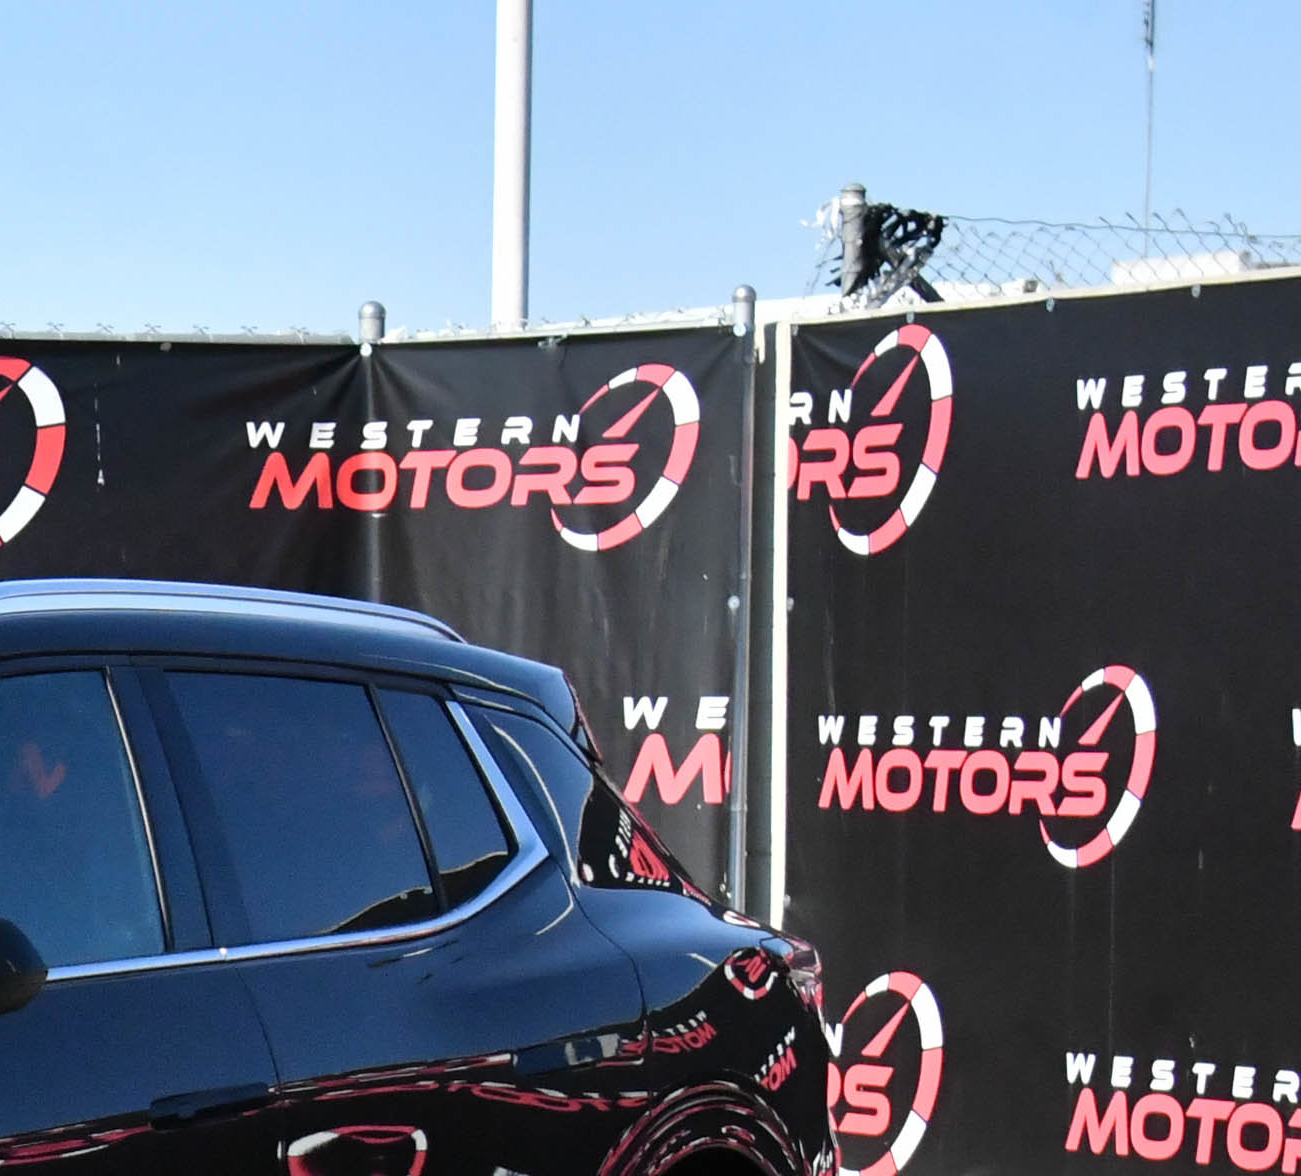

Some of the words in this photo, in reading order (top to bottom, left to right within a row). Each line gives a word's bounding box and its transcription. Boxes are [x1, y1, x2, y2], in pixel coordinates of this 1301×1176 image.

[245, 413, 582, 451] WESTERN
[1075, 399, 1301, 480] MOTO
[249, 442, 640, 513] MOTORS
[817, 714, 1063, 749] WESTERN
[818, 746, 1111, 818] MOTORS
